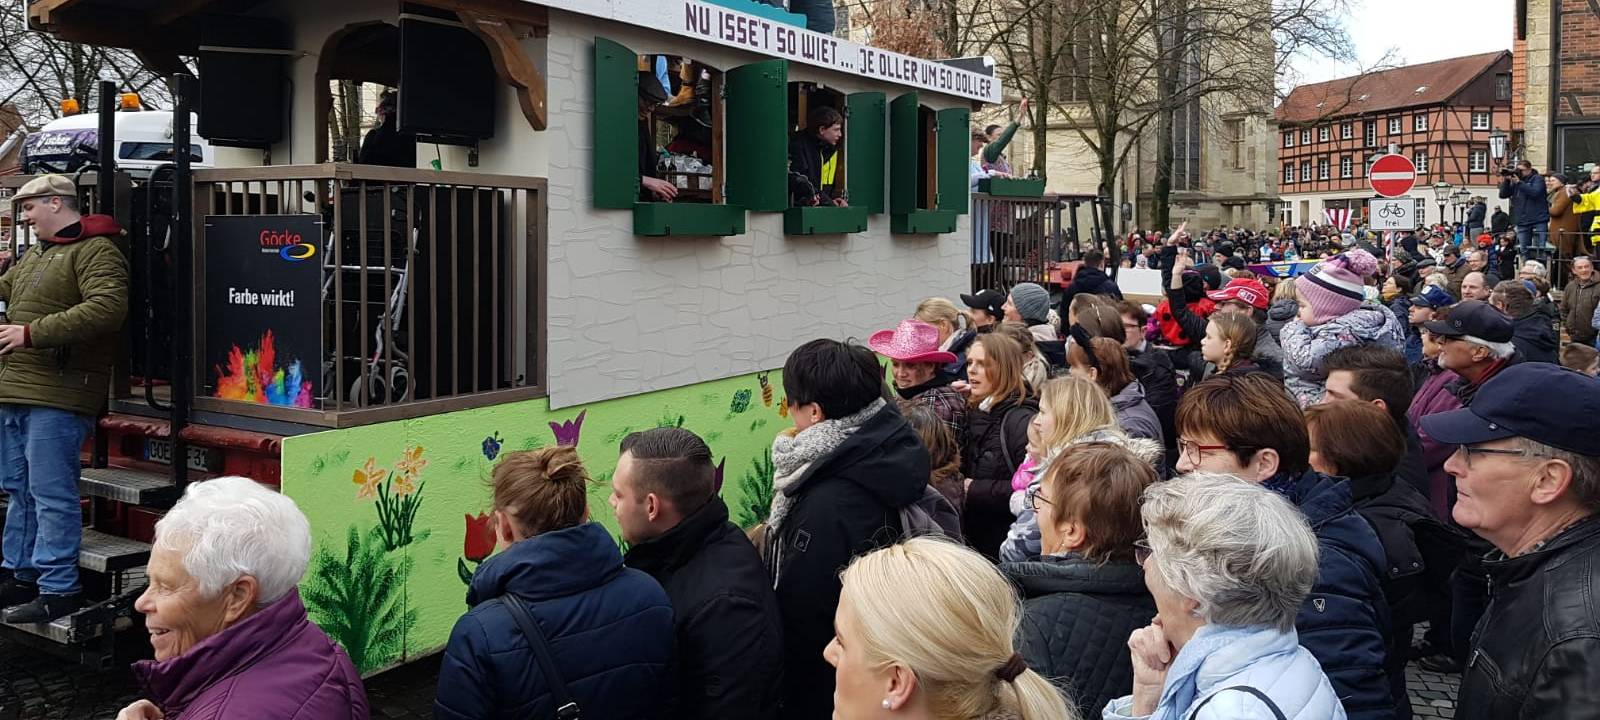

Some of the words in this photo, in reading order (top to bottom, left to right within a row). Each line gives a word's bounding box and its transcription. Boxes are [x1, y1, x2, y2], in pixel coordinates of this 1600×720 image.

[685, 2, 710, 35] NU
[777, 26, 796, 55] SO
[859, 48, 874, 73] JE
[879, 53, 918, 83] OLLER
[921, 63, 937, 87] UM
[940, 68, 952, 90] SO
[955, 72, 991, 98] DOLLER
[1385, 219, 1400, 227] frei
[229, 287, 258, 305] Farbe
[261, 289, 295, 307] wirkt!
